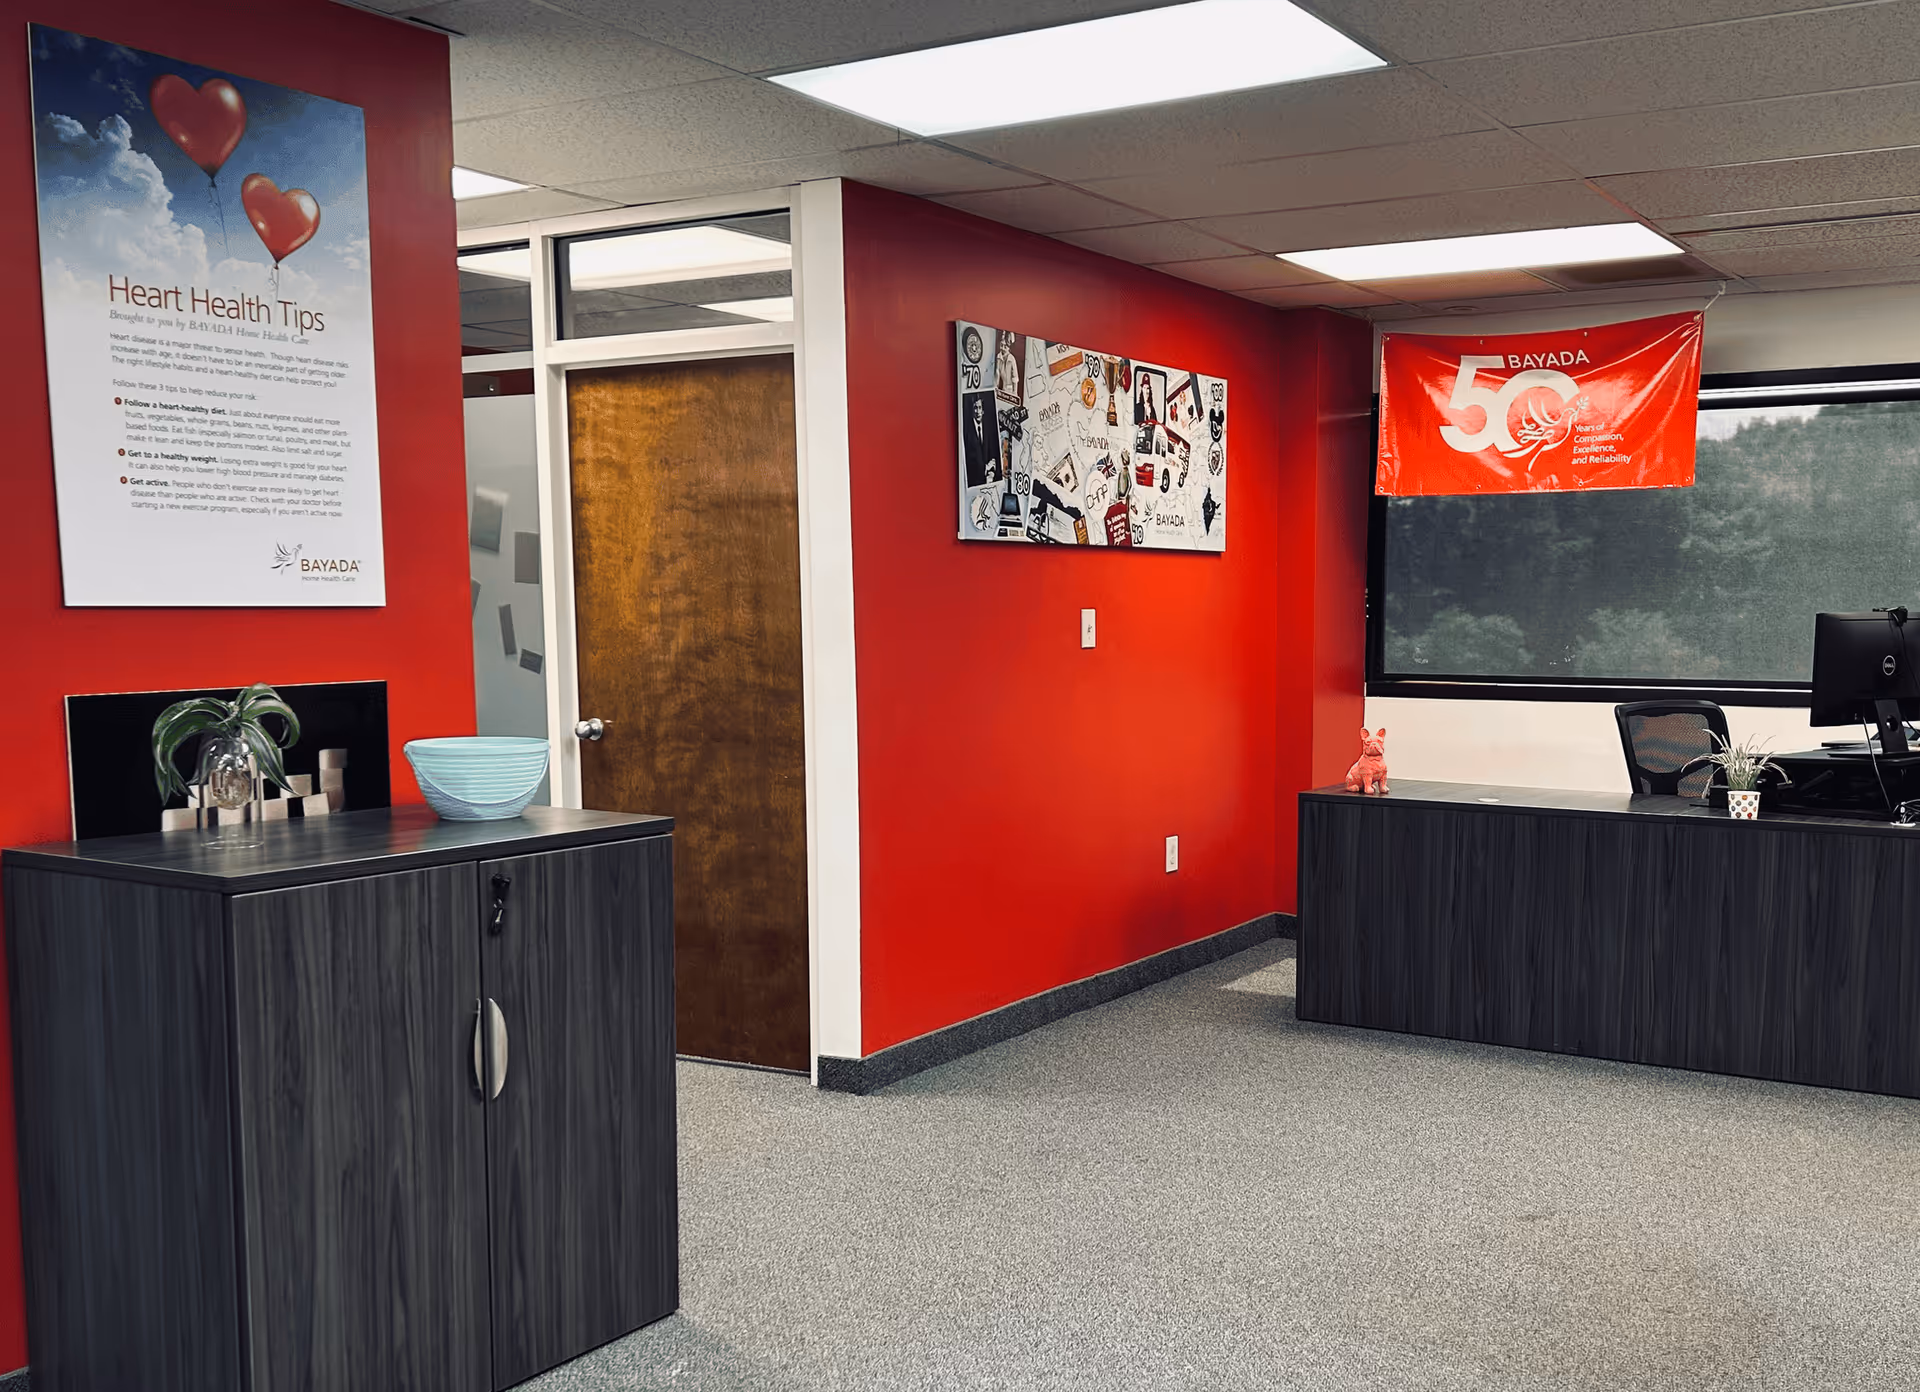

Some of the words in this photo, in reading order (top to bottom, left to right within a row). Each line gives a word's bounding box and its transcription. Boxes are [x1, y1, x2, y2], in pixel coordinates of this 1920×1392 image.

[108, 273, 183, 311] Heart
[190, 285, 270, 324] Health
[277, 298, 325, 339] Tips
[108, 308, 144, 326] Brought
[145, 315, 155, 324] to
[156, 318, 173, 329] you
[175, 317, 186, 331] by
[188, 319, 233, 334] BAYADA
[109, 332, 129, 341] Heart
[1507, 349, 1590, 369] BAYADA
[112, 378, 136, 388] Follow
[123, 398, 150, 408] Follow
[159, 402, 209, 415] heart-healthy
[210, 406, 227, 415] diet.
[1439, 355, 1580, 455] 50
[1574, 424, 1595, 432] Years
[1595, 421, 1605, 431] of
[1573, 433, 1624, 443] Compassion,
[1573, 445, 1616, 454] Excellence,
[127, 449, 142, 457] Get
[160, 451, 189, 462] healthy
[190, 454, 218, 464] weight.
[1571, 455, 1588, 464] and
[1589, 453, 1632, 465] Reliability
[129, 477, 144, 485] Get
[145, 478, 170, 486] active.
[1156, 514, 1185, 527] BAYADA
[300, 558, 359, 572] BAYADA
